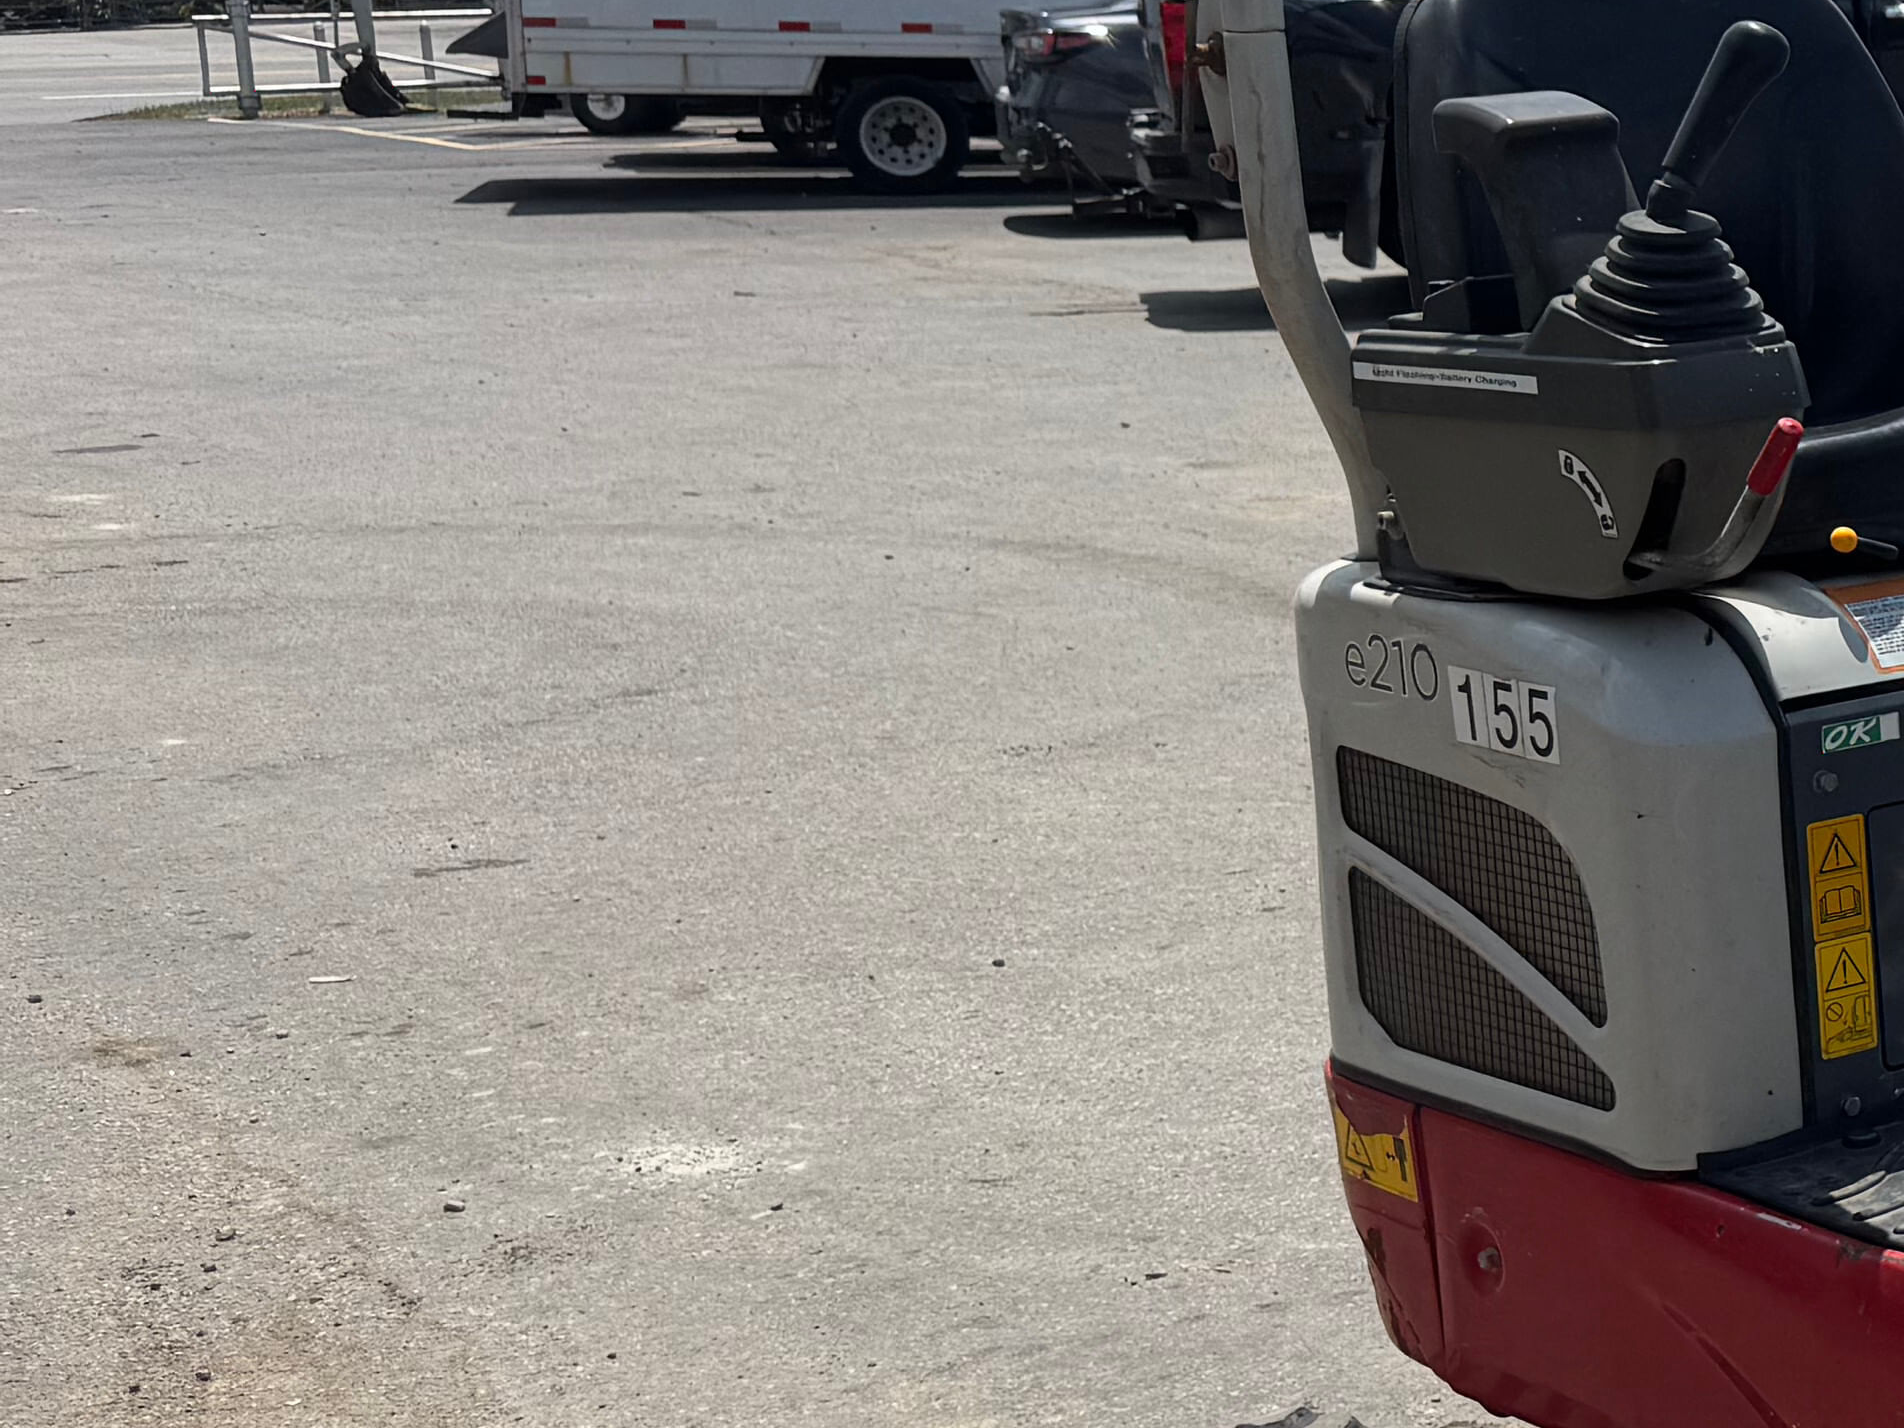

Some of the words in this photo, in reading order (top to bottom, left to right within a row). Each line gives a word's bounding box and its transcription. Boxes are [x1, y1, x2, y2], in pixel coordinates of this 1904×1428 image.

[1344, 633, 1440, 702] e210
[1456, 673, 1555, 758] 155
[1825, 717, 1877, 750] OK
